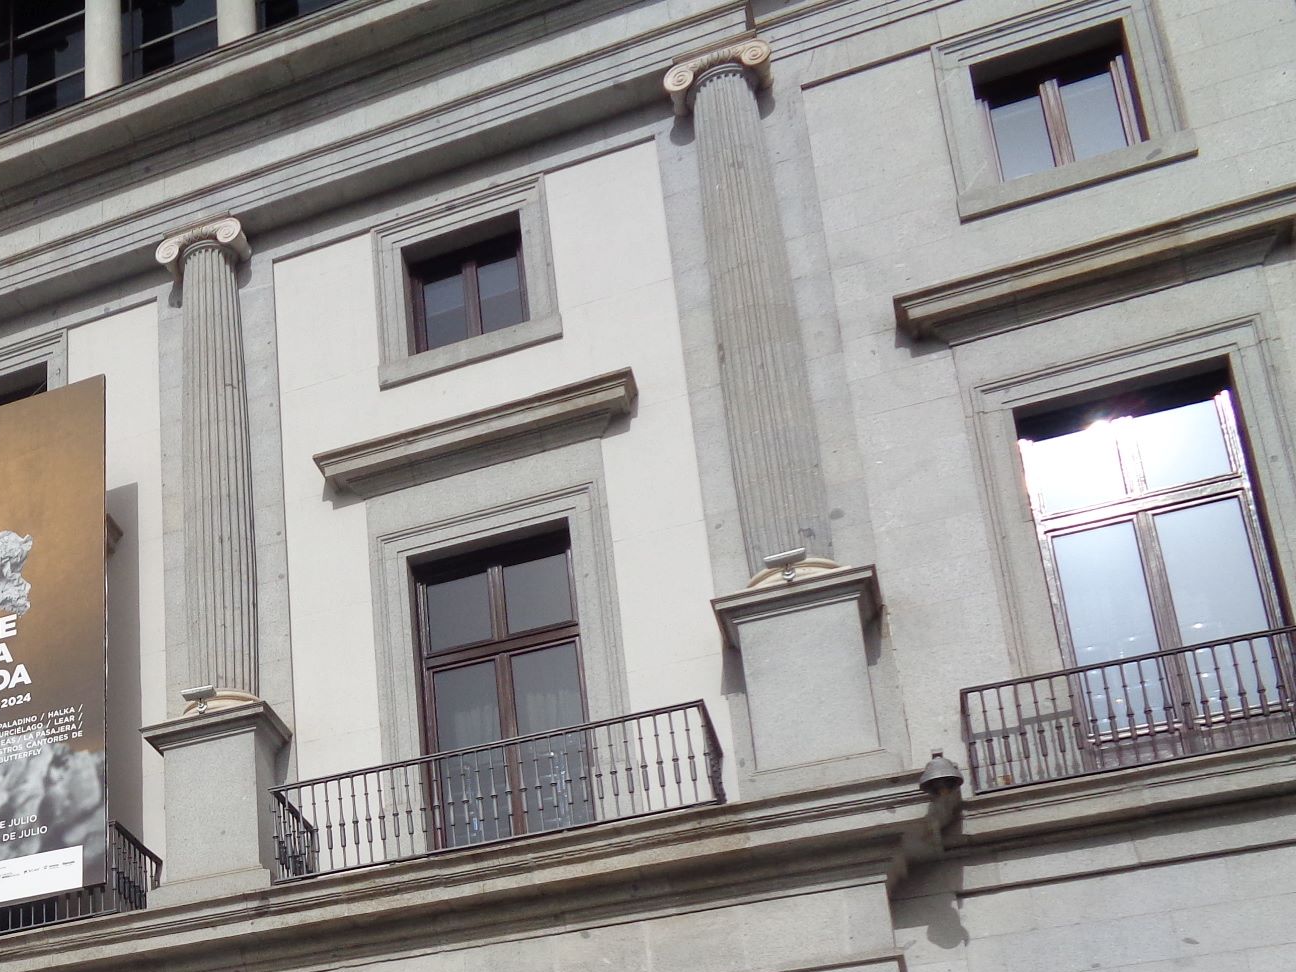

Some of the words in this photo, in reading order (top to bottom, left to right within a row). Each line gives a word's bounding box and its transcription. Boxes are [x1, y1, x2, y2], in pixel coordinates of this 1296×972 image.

[1, 692, 32, 708] 2024
[48, 707, 75, 719] HALKA
[54, 714, 75, 726] LEAR
[24, 733, 34, 741] LA
[36, 724, 77, 738] PASAJERA
[26, 733, 68, 748] CANTORES
[72, 730, 83, 738] DE
[8, 814, 38, 827] JULIO
[3, 831, 16, 842] DE
[19, 825, 48, 839] JULIO
